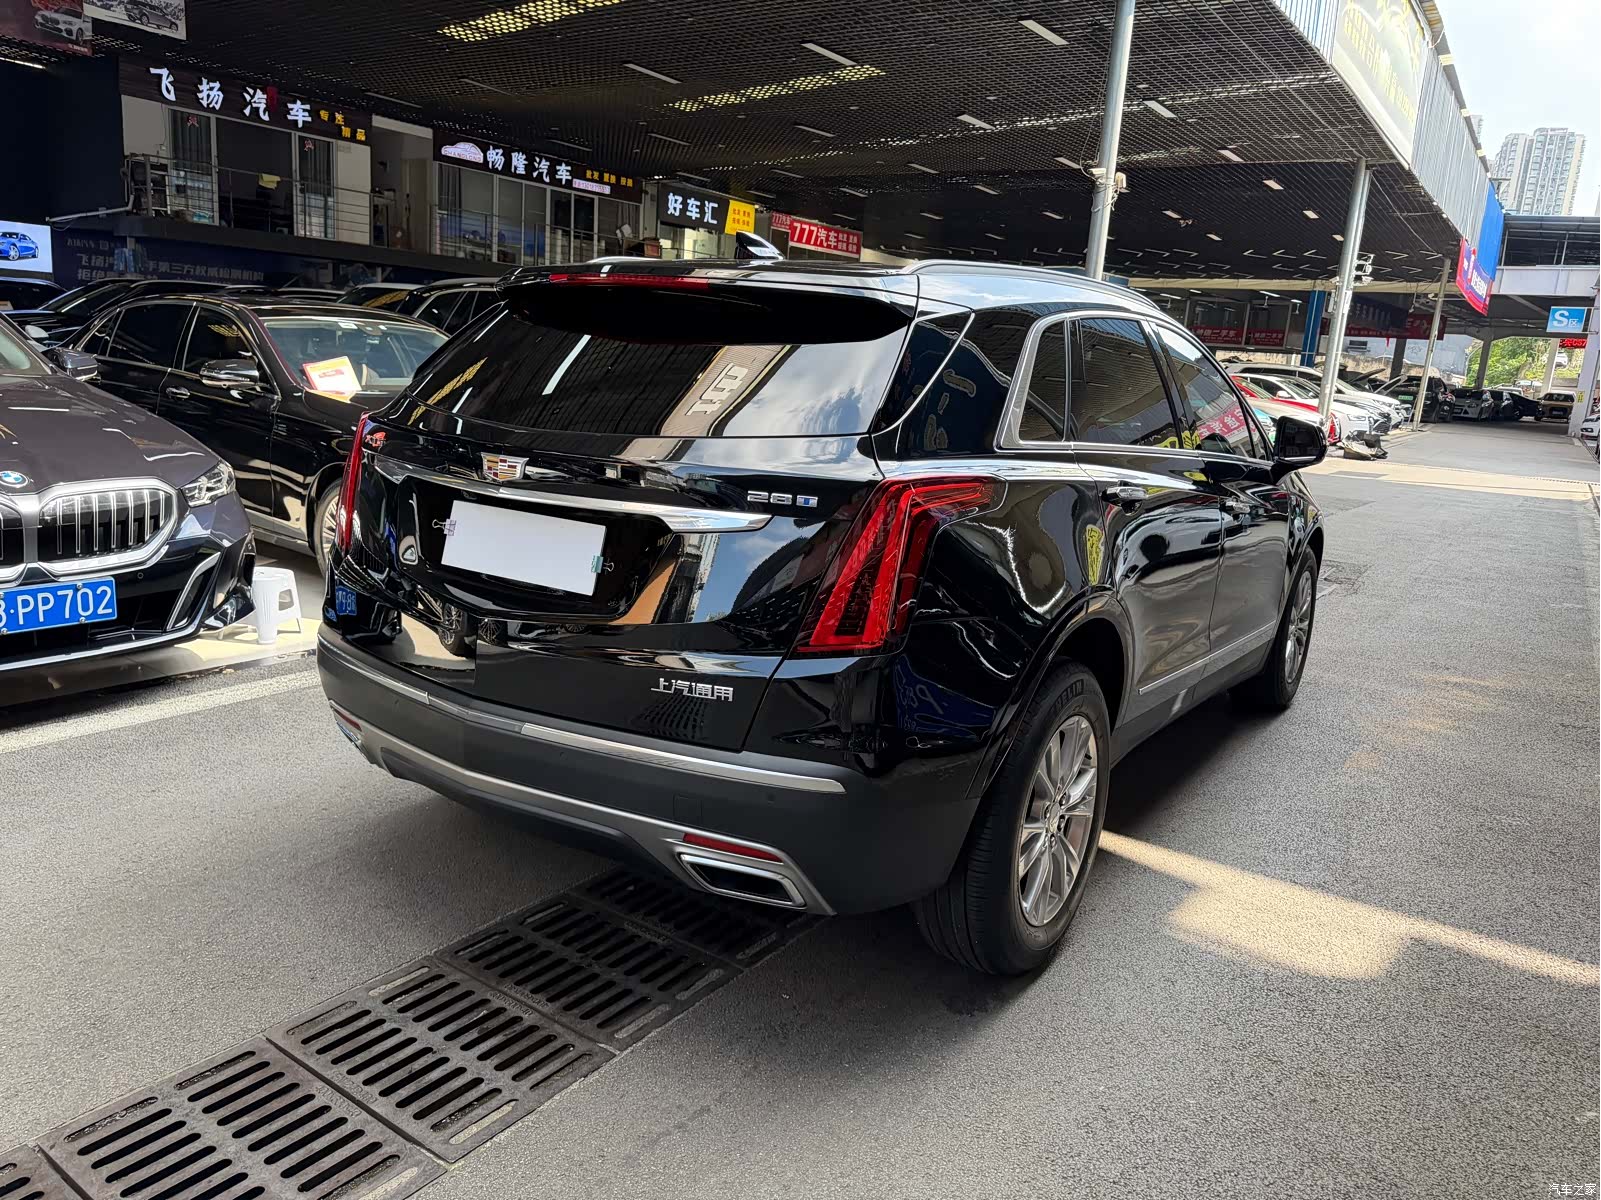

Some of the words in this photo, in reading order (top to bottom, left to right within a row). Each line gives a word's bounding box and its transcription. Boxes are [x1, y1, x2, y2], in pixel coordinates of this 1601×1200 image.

[149, 67, 312, 129] 飞扬汽车
[486, 145, 572, 185] 畅隆汽车
[667, 191, 719, 225] 好车汇
[793, 222, 838, 249] 777汽车
[1552, 310, 1579, 328] S区
[747, 490, 818, 508] 28T
[650, 677, 735, 703] 上汽通用
